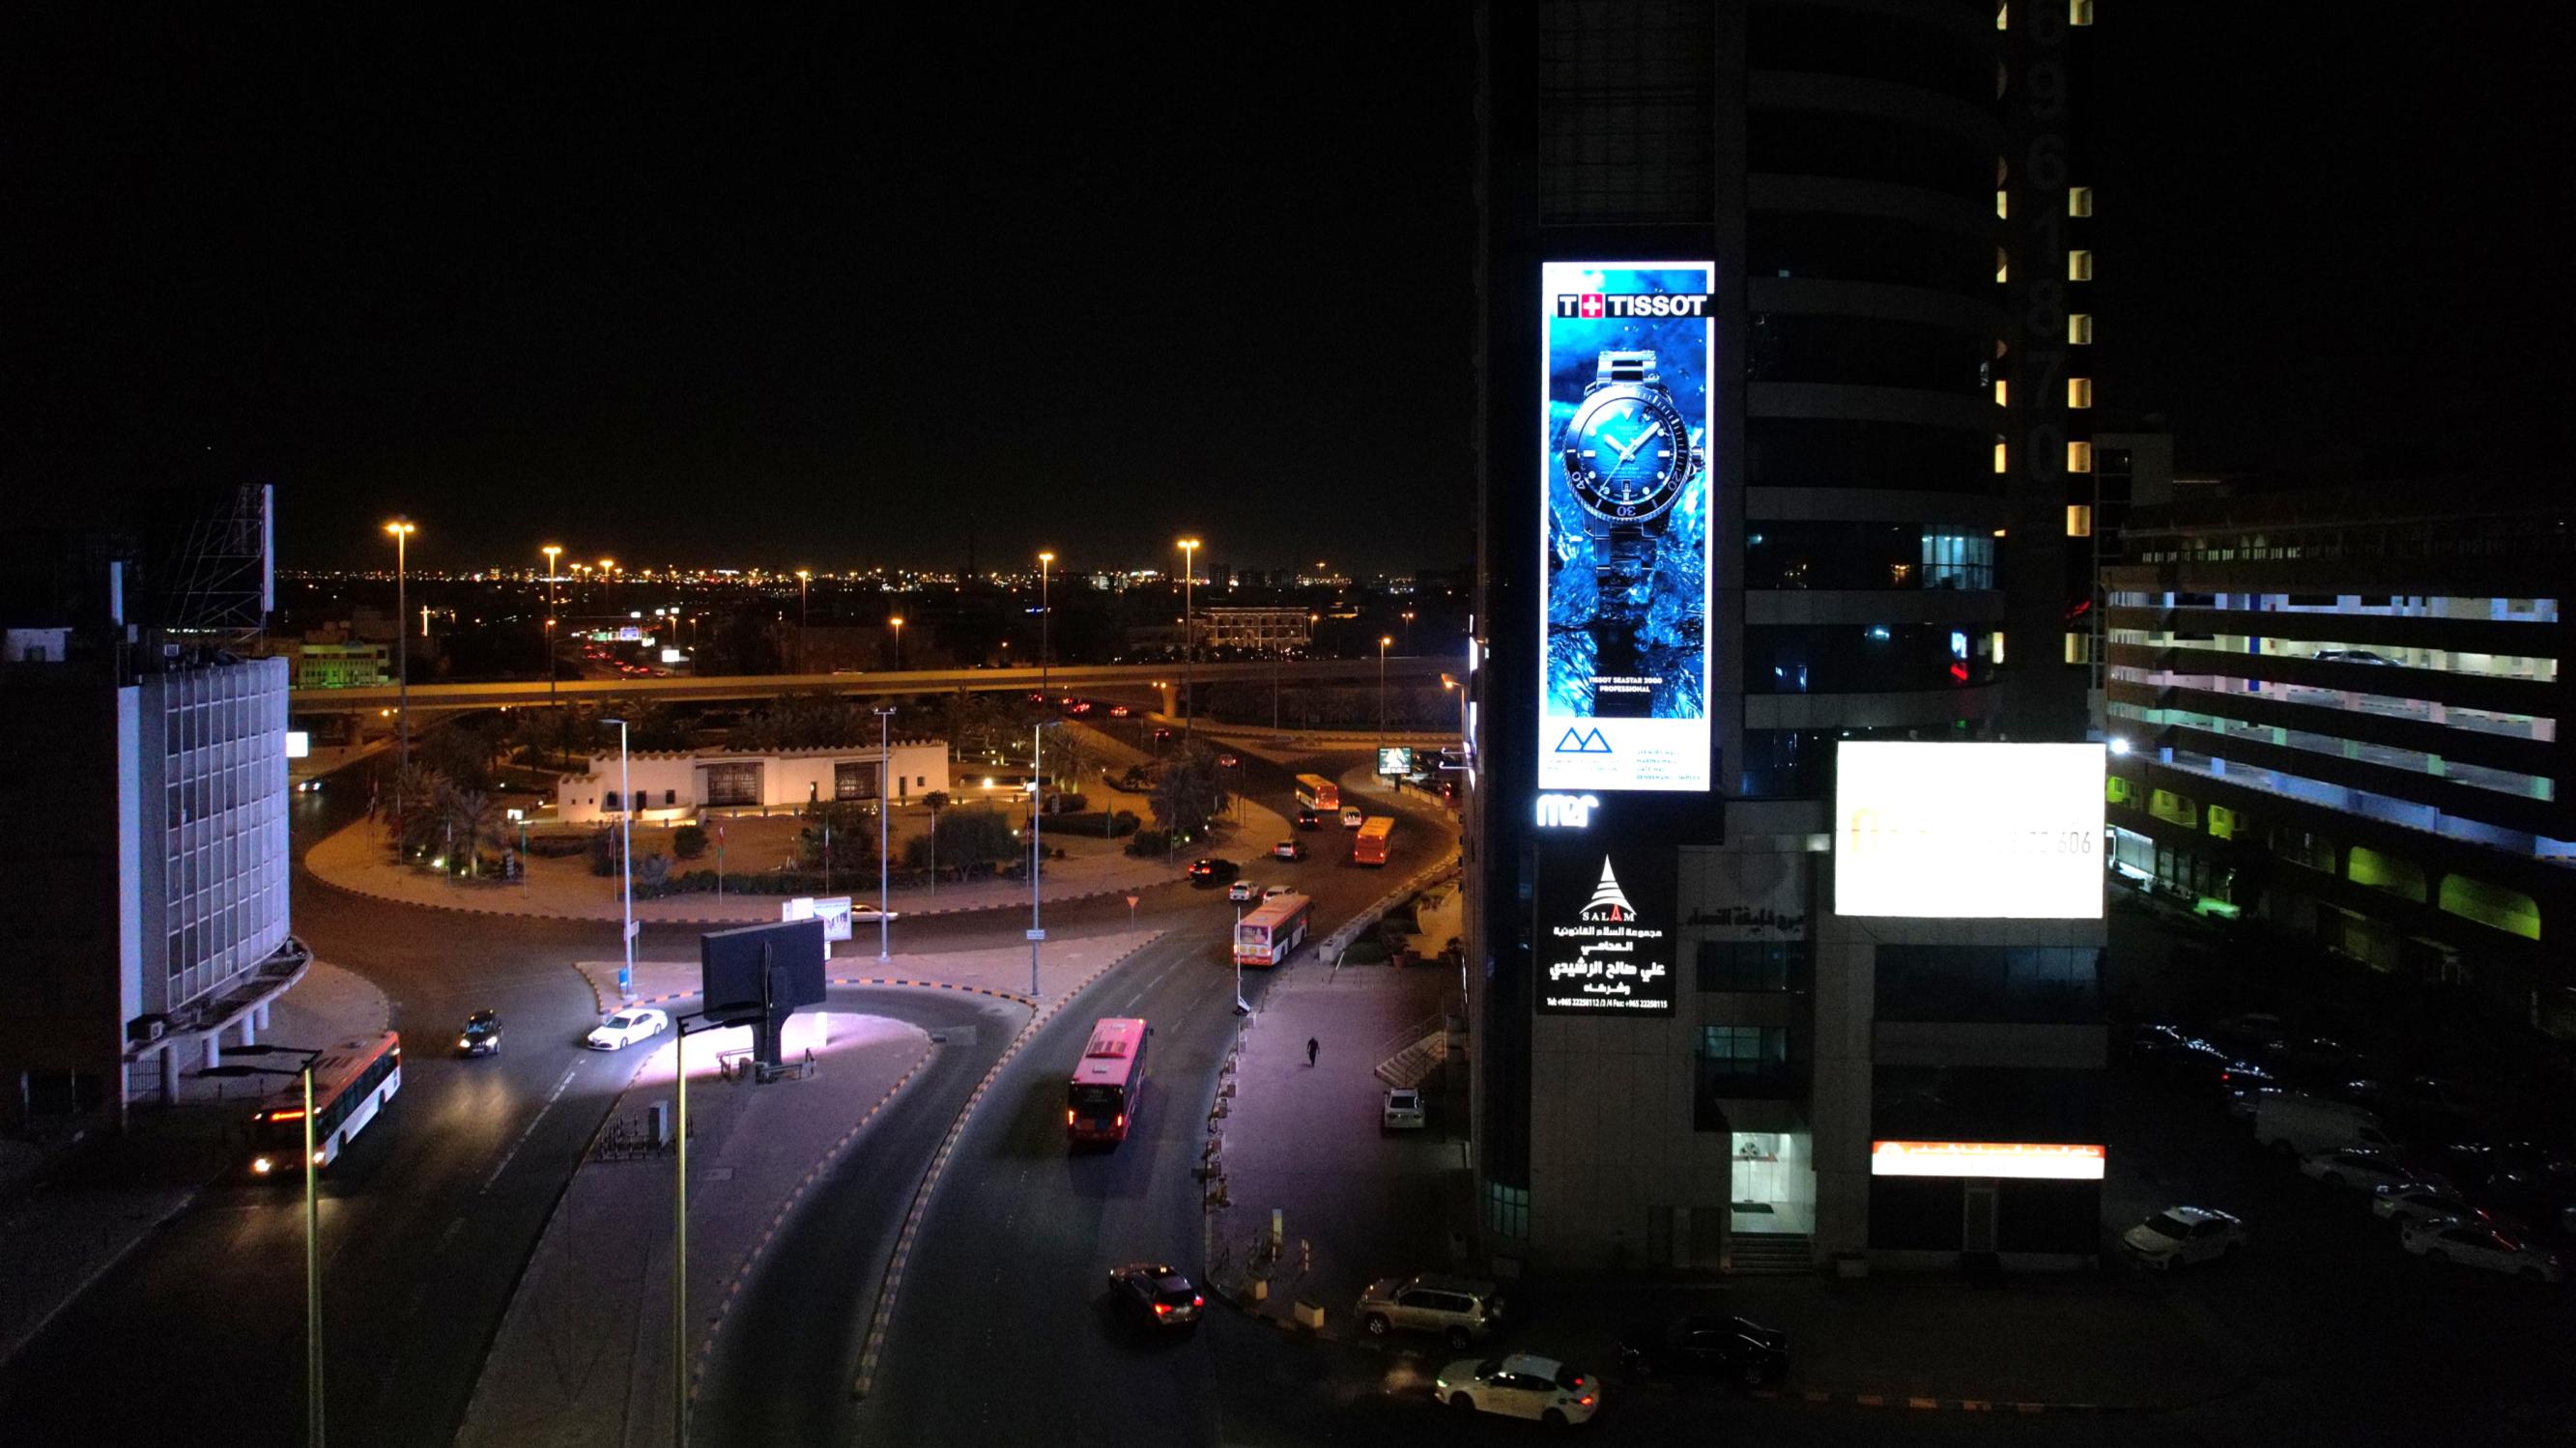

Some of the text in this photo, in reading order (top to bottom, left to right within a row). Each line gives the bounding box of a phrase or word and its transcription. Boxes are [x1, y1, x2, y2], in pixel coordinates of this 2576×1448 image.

[1608, 295, 1707, 317] TISSOT
[1616, 505, 1637, 517] 30
[1613, 676, 1643, 685] SEASTAR
[1582, 904, 1635, 923] SALAM
[1553, 925, 1662, 938] مجموعة السلام القانونية
[1580, 941, 1634, 955] المحامي
[1549, 955, 1666, 982] علي صالح الرشيدي
